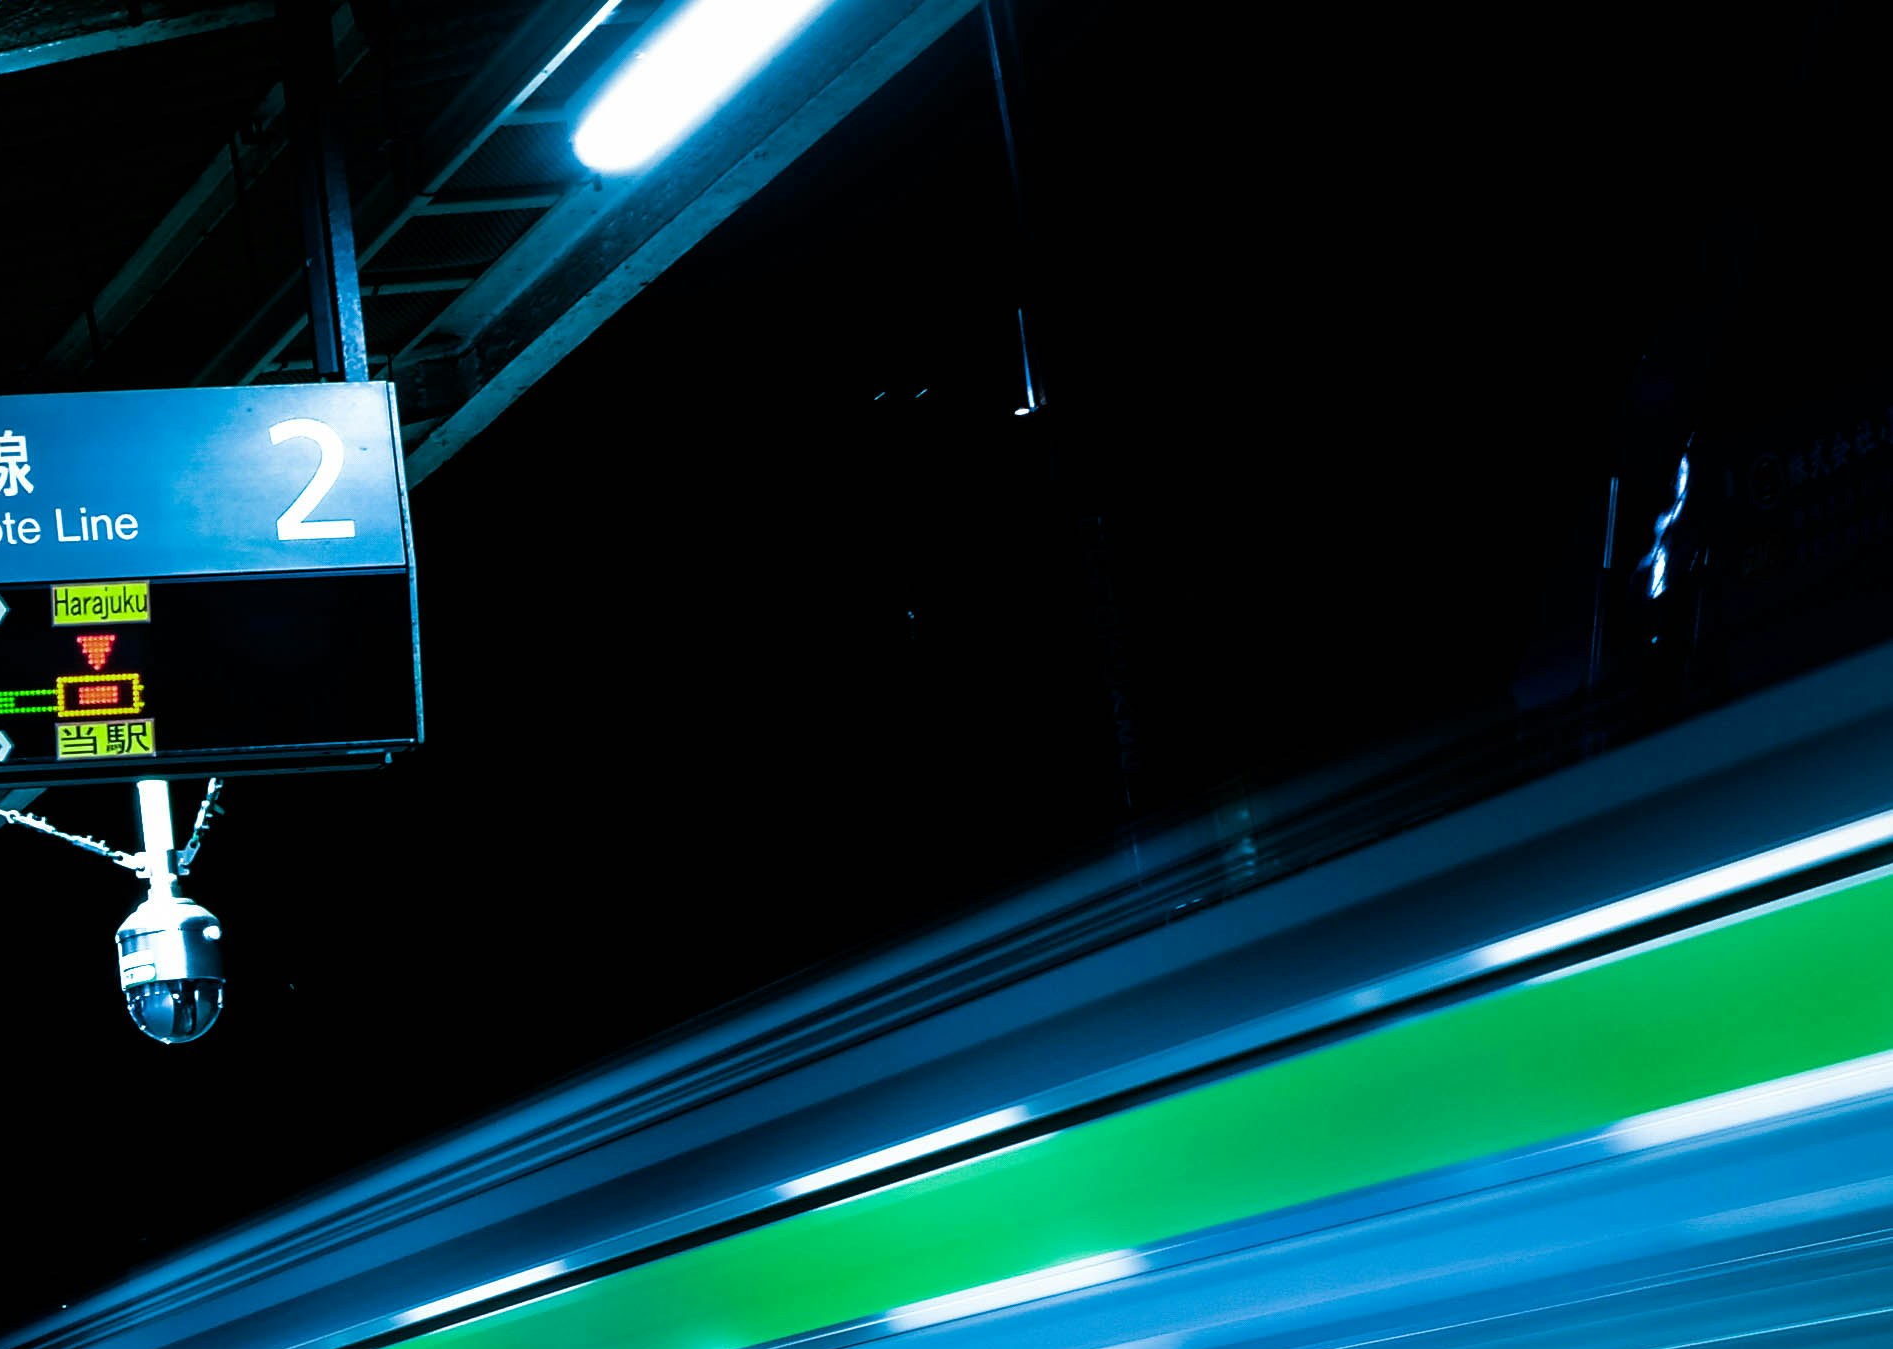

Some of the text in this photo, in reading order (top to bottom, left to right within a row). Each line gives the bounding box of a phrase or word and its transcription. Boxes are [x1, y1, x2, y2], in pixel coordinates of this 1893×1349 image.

[268, 418, 356, 541] 2
[56, 506, 139, 543] Line
[54, 587, 148, 620] Harajuku
[60, 722, 150, 756] 当駅
